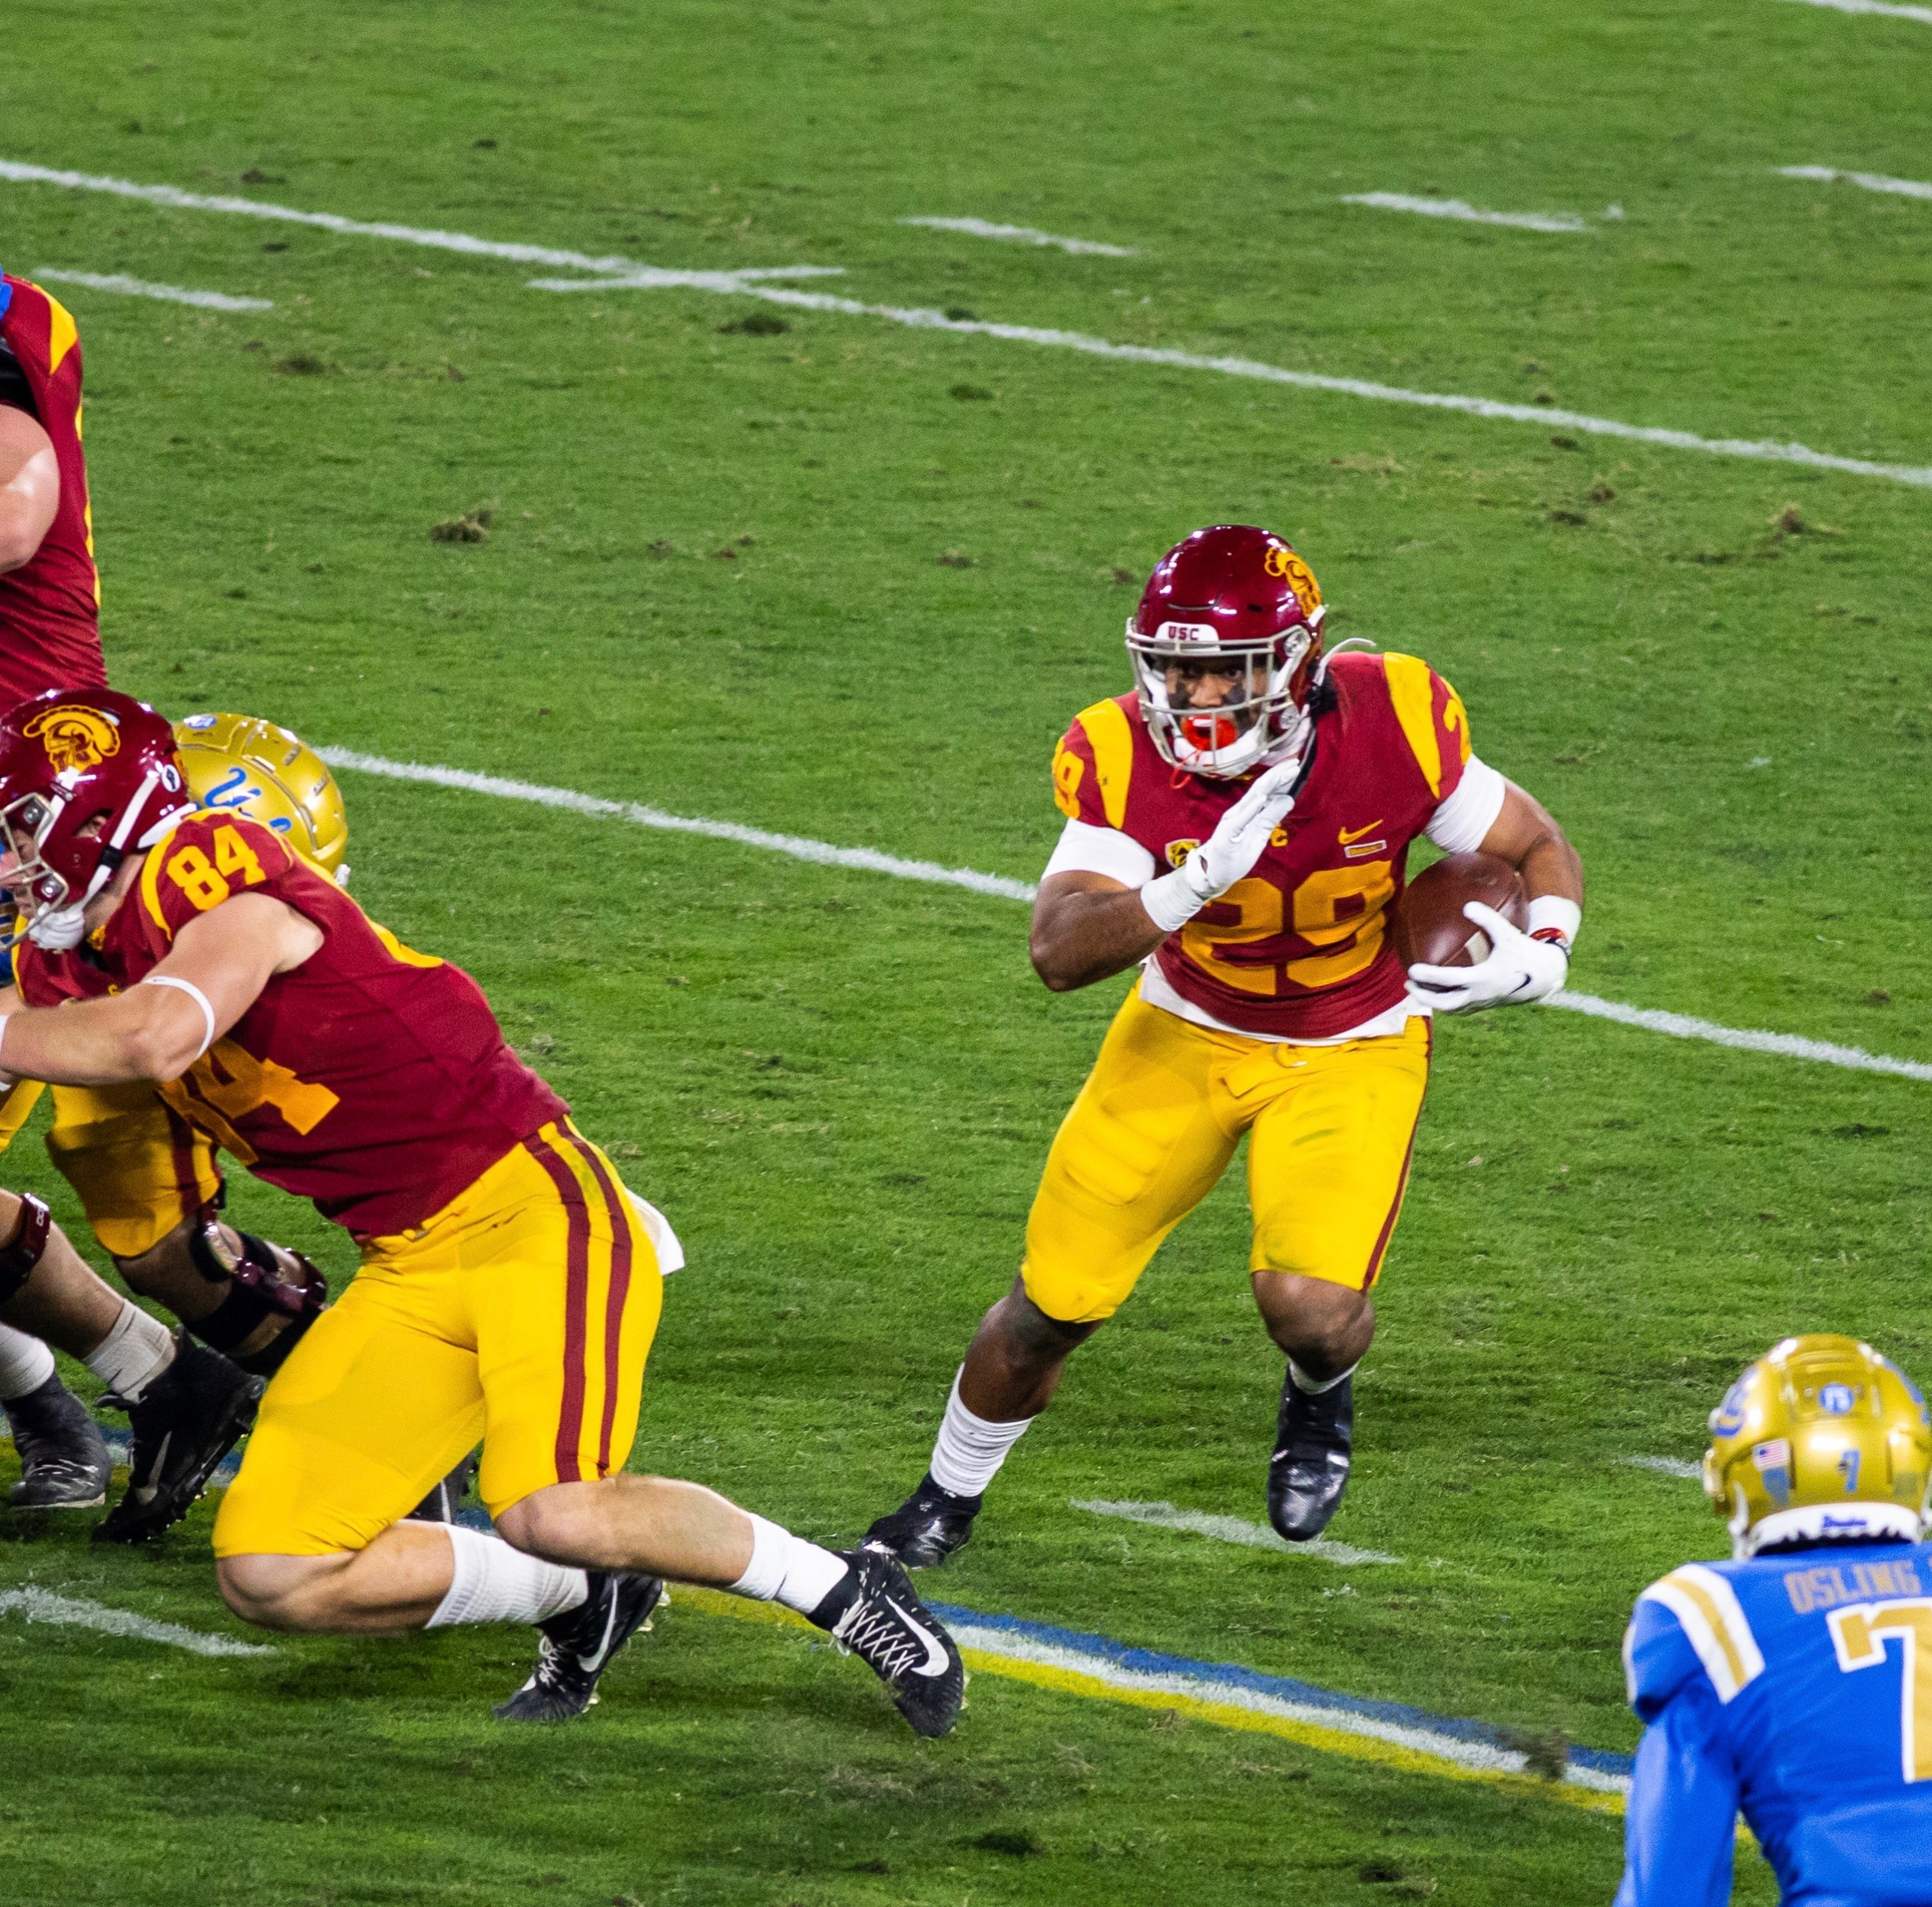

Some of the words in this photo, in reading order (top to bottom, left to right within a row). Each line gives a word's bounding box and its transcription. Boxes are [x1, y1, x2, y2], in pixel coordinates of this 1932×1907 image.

[1168, 626, 1199, 641] USC
[166, 824, 266, 912] 84
[1181, 860, 1395, 995] 29
[1783, 1558, 1921, 1614] OSLING
[1826, 1597, 1932, 1784] 7
